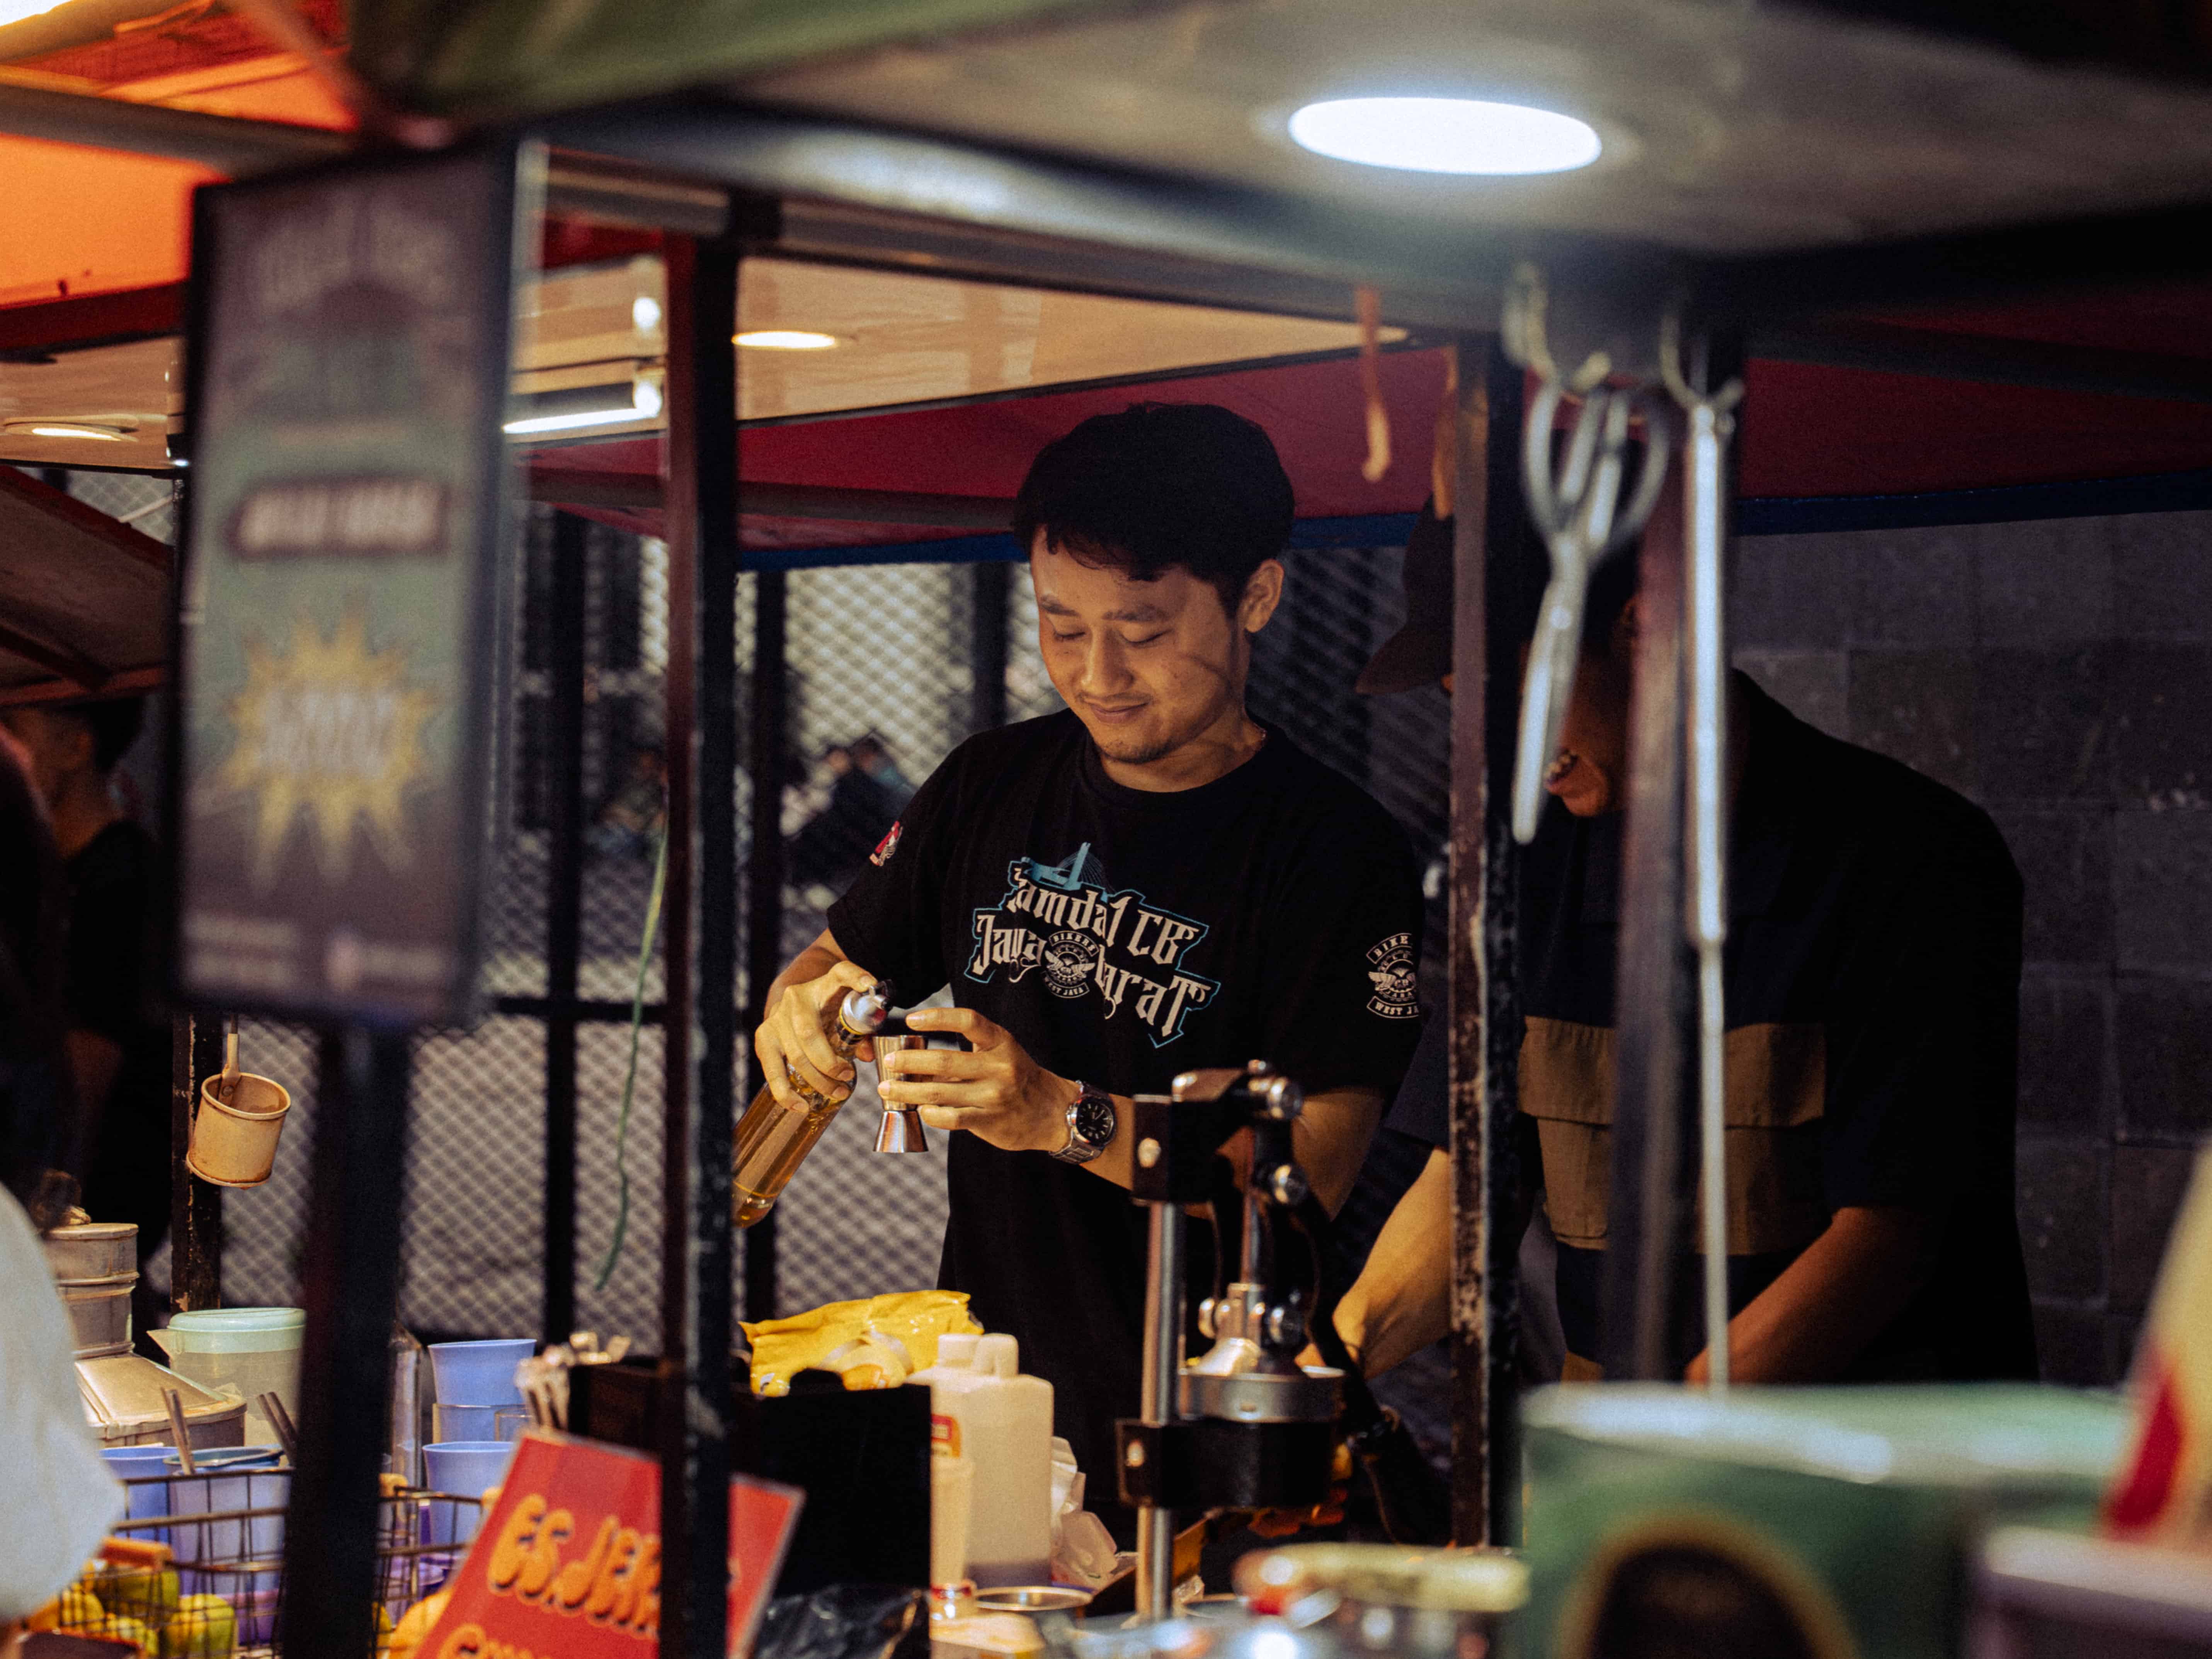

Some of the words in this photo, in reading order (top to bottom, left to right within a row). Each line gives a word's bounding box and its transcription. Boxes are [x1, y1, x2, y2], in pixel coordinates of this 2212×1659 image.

[1053, 932, 1096, 951] BIKERS
[1373, 935, 1409, 957] BIKE
[1063, 987, 1084, 996] JAVA
[1375, 1002, 1403, 1015] WEST
[1407, 1006, 1419, 1015] JA
